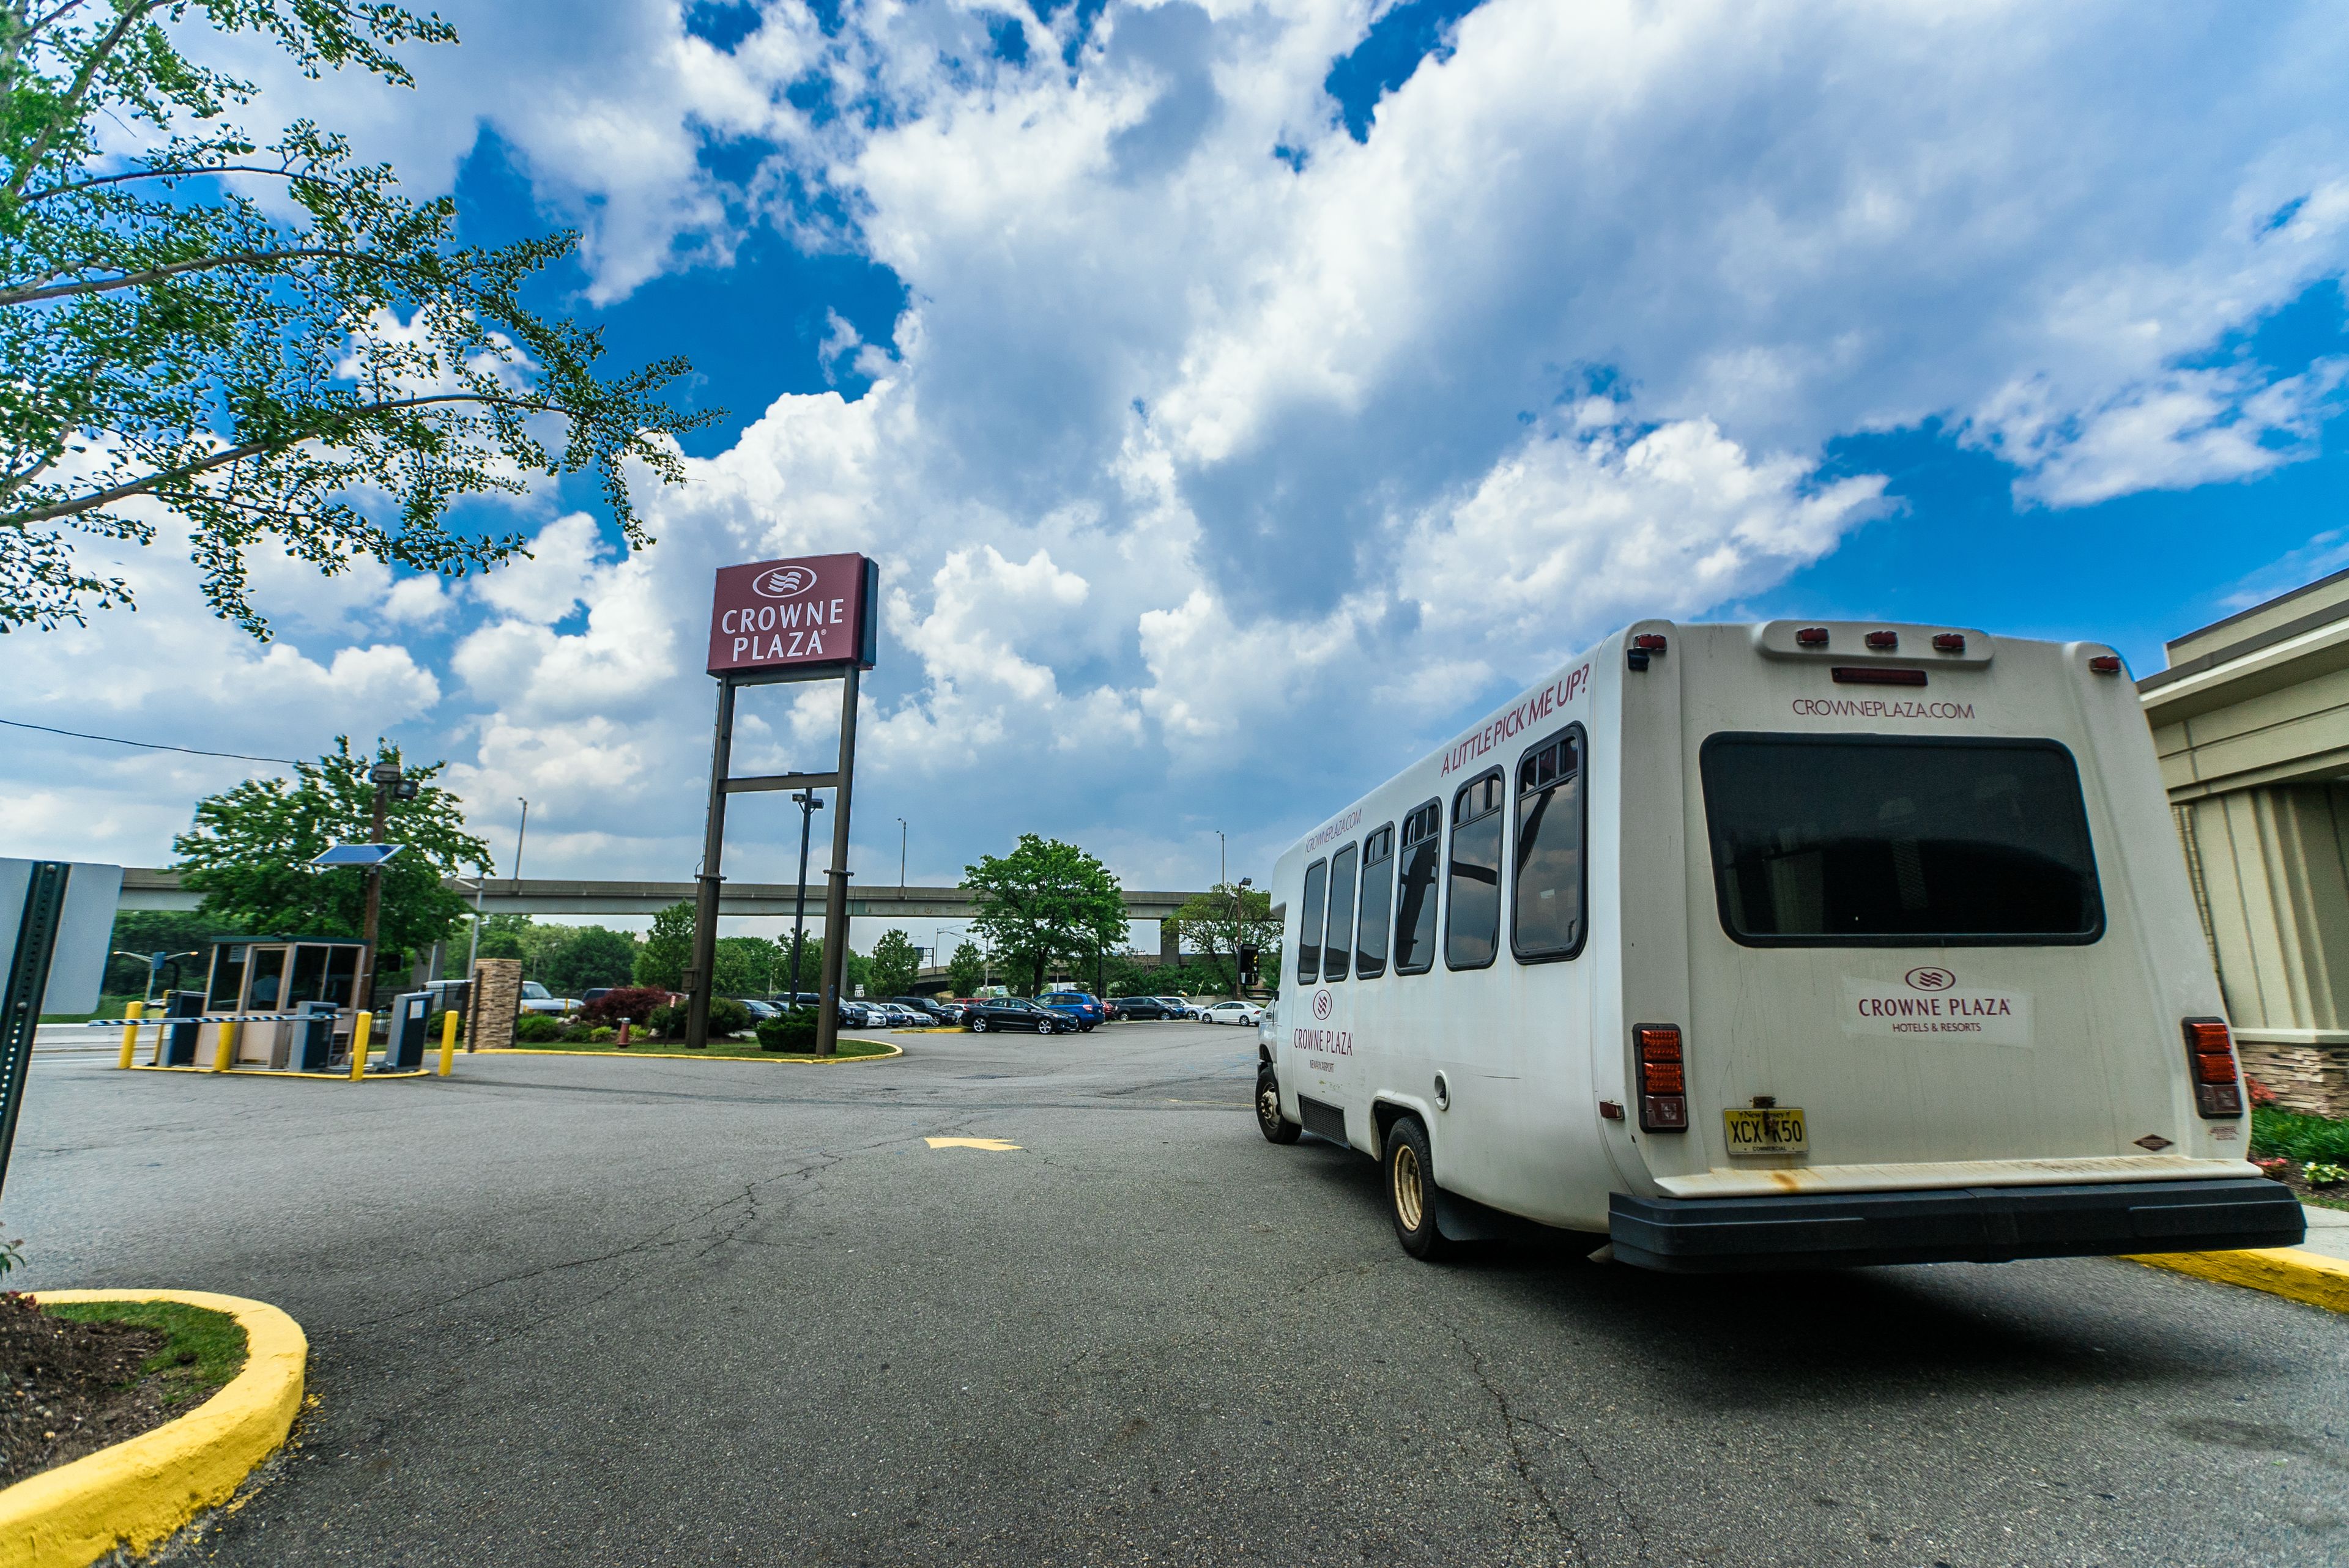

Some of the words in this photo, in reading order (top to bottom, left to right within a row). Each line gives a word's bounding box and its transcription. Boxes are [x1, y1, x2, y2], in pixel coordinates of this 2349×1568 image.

[722, 598, 844, 634] CROWNE
[1441, 753, 1449, 777] A
[1452, 725, 1492, 771] LITTLE
[1494, 703, 1527, 747] PICK
[1528, 686, 1554, 726] ME
[1556, 663, 1590, 707] UP?
[1792, 699, 1975, 719] CROWNEPLAZA.COM
[1858, 999, 1942, 1016] CROWNE
[1893, 1023, 1929, 1032] HOTELS
[1931, 1023, 1939, 1032] &
[1941, 1023, 1981, 1032] RESORTS
[1294, 1028, 1323, 1051] CROWNE
[1730, 1120, 1763, 1143] XCX
